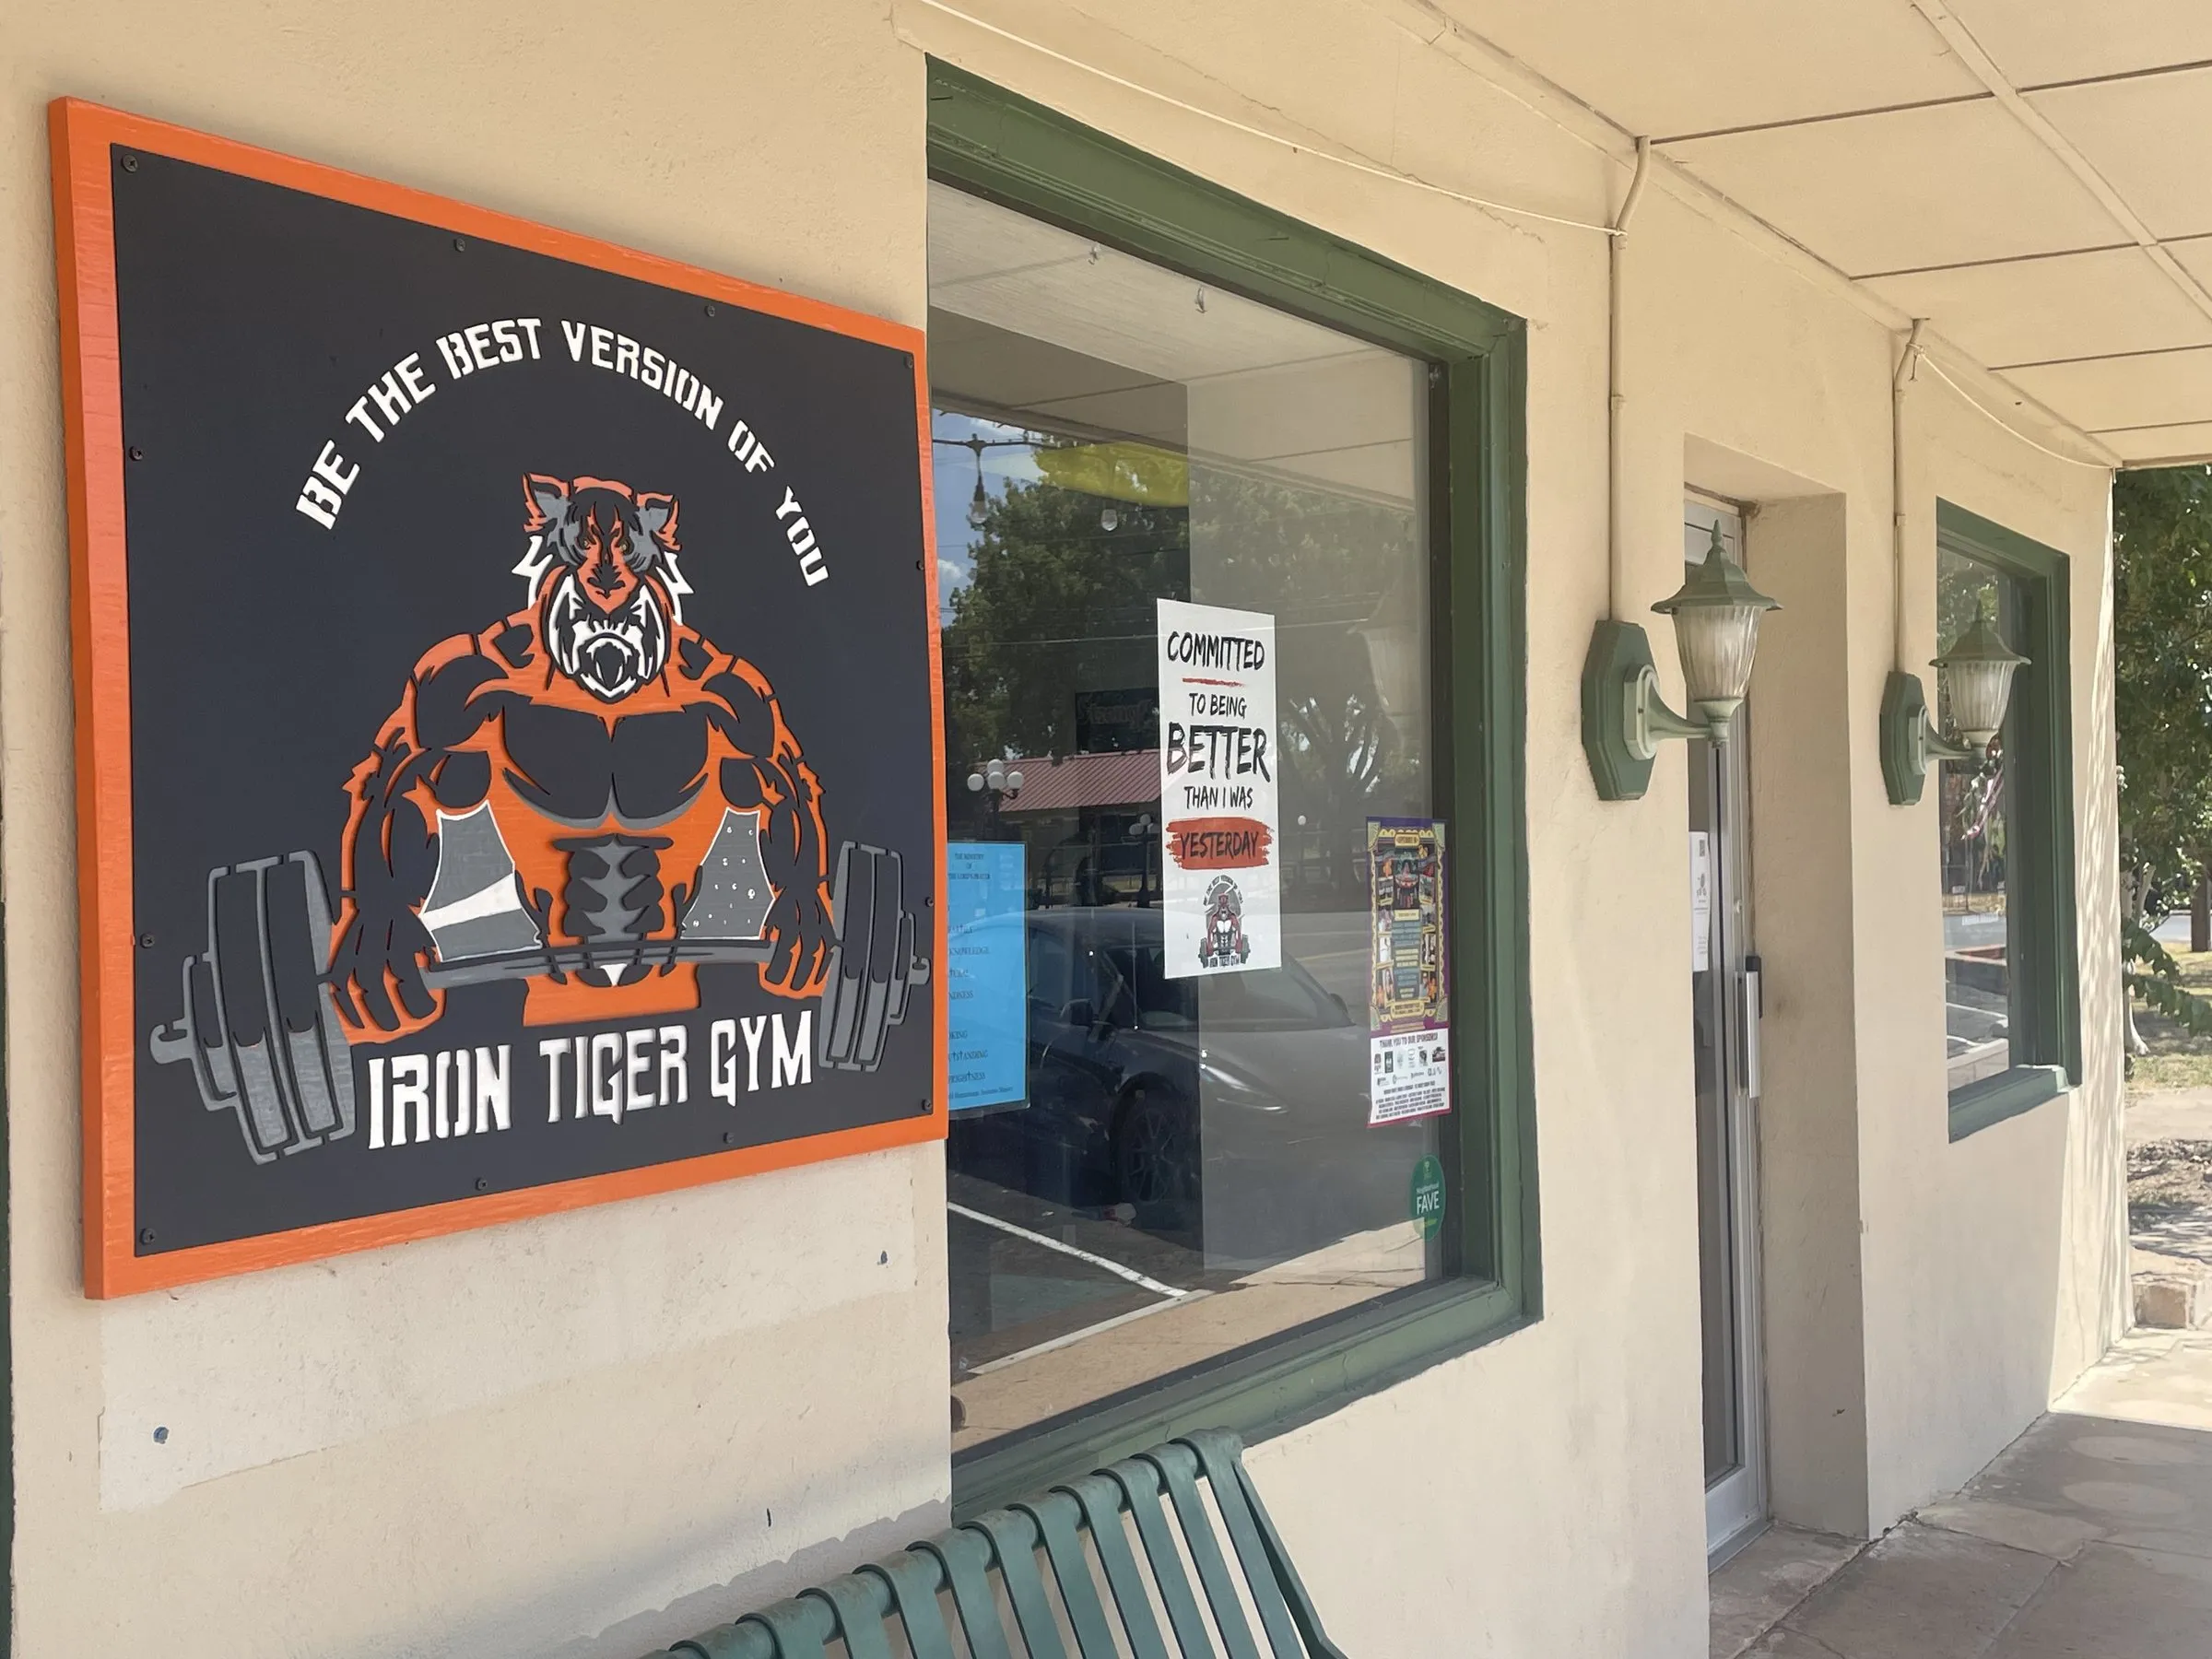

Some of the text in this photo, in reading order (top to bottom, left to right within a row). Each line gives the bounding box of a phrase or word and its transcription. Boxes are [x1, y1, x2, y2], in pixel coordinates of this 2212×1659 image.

[296, 317, 829, 587] BE THE BEST VERSION OF YOU
[1167, 631, 1265, 671] COMMITTED
[1189, 692, 1247, 719] TO BEING
[1167, 721, 1270, 782] BETTER
[1183, 785, 1253, 810] THAN I WAS
[1180, 830, 1259, 860] YESTERDAY
[368, 1010, 813, 1149] IRON TIGER GYM
[1417, 1190, 1440, 1215] FAVE
